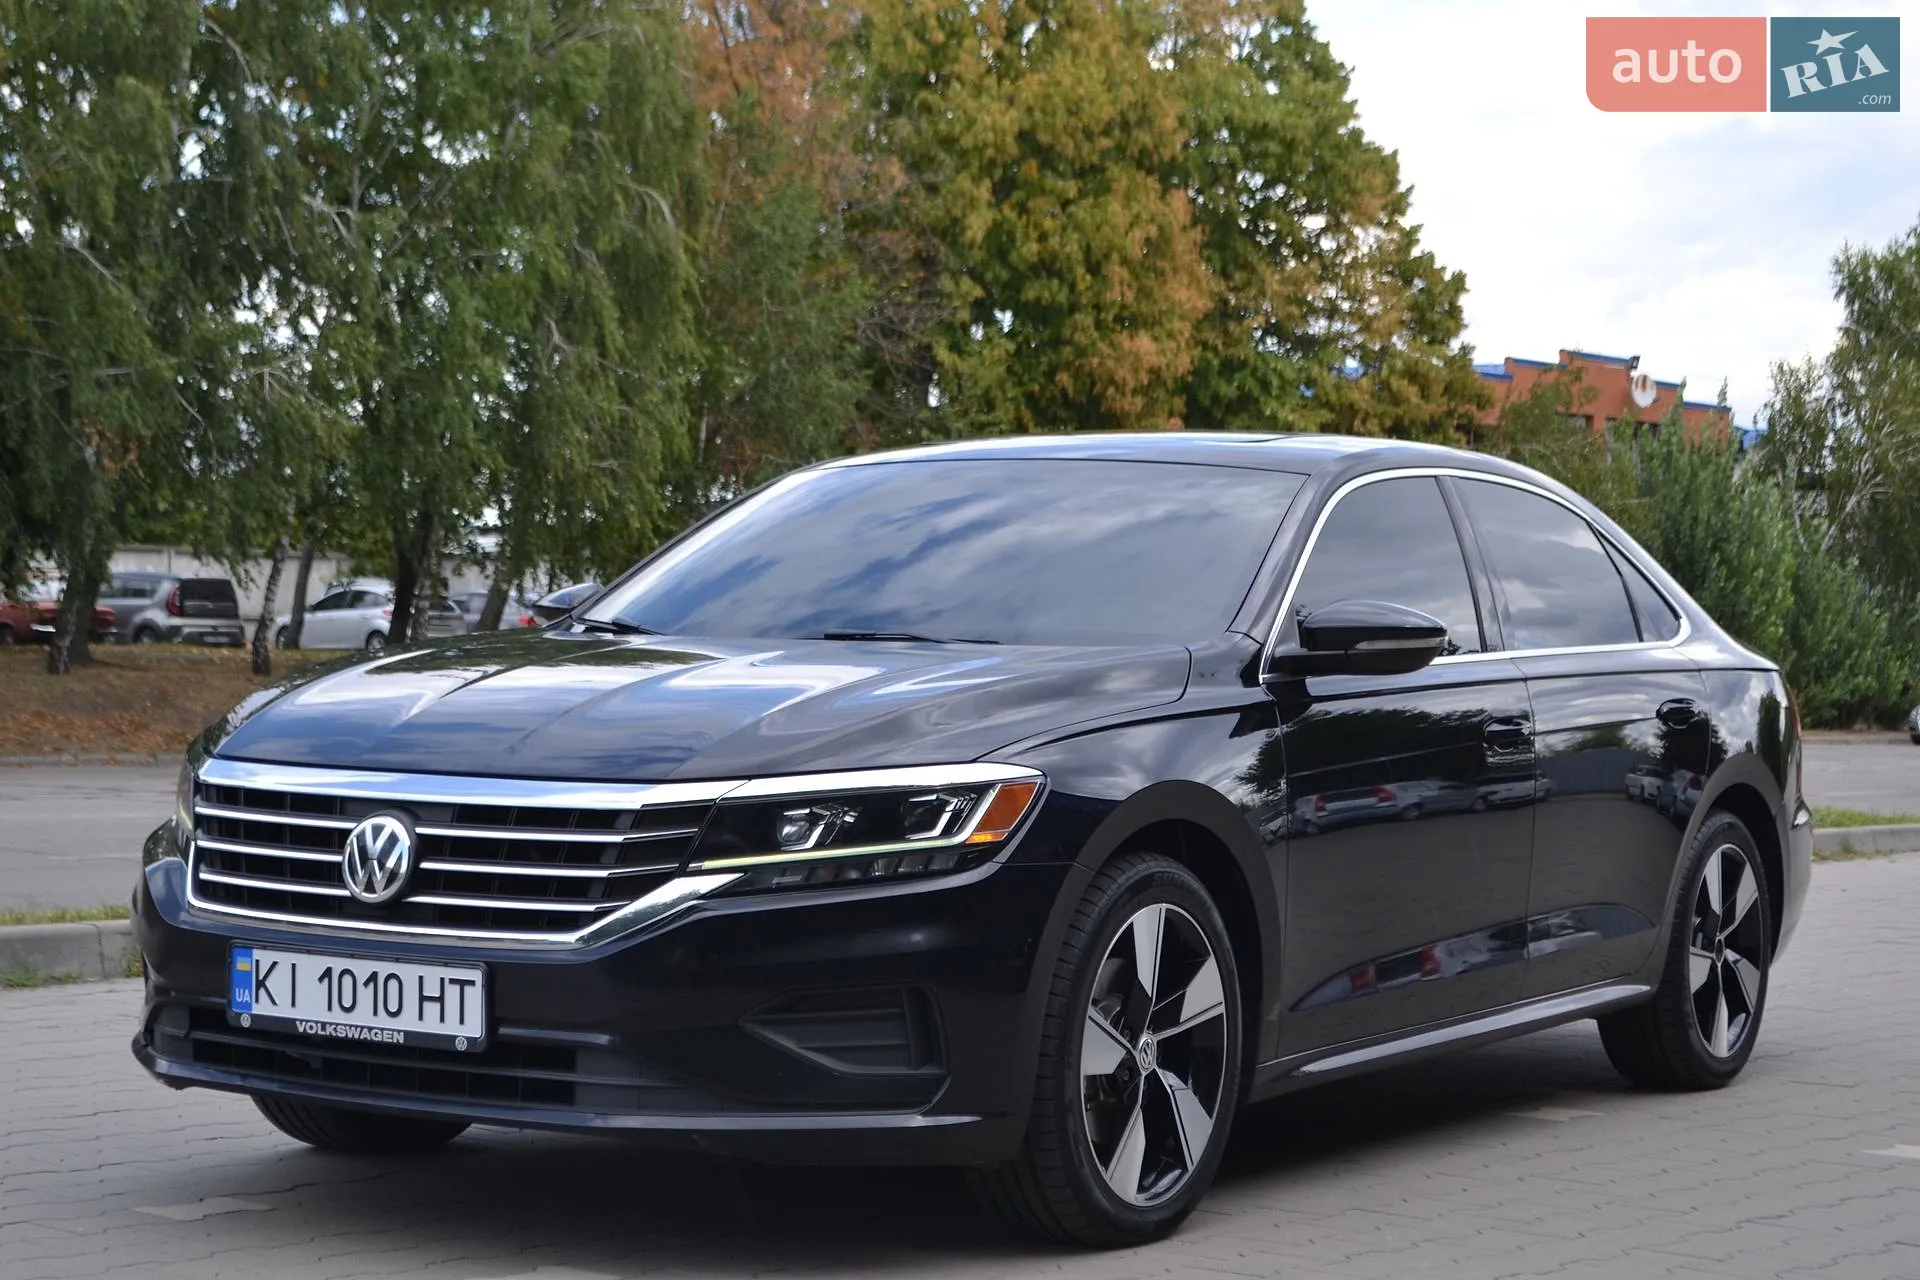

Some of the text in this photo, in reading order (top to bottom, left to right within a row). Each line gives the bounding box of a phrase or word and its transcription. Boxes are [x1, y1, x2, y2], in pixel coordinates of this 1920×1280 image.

[235, 988, 252, 1004] UA
[254, 958, 476, 1025] KI 1010 HT
[296, 1020, 405, 1044] VOLKSWAGEN
